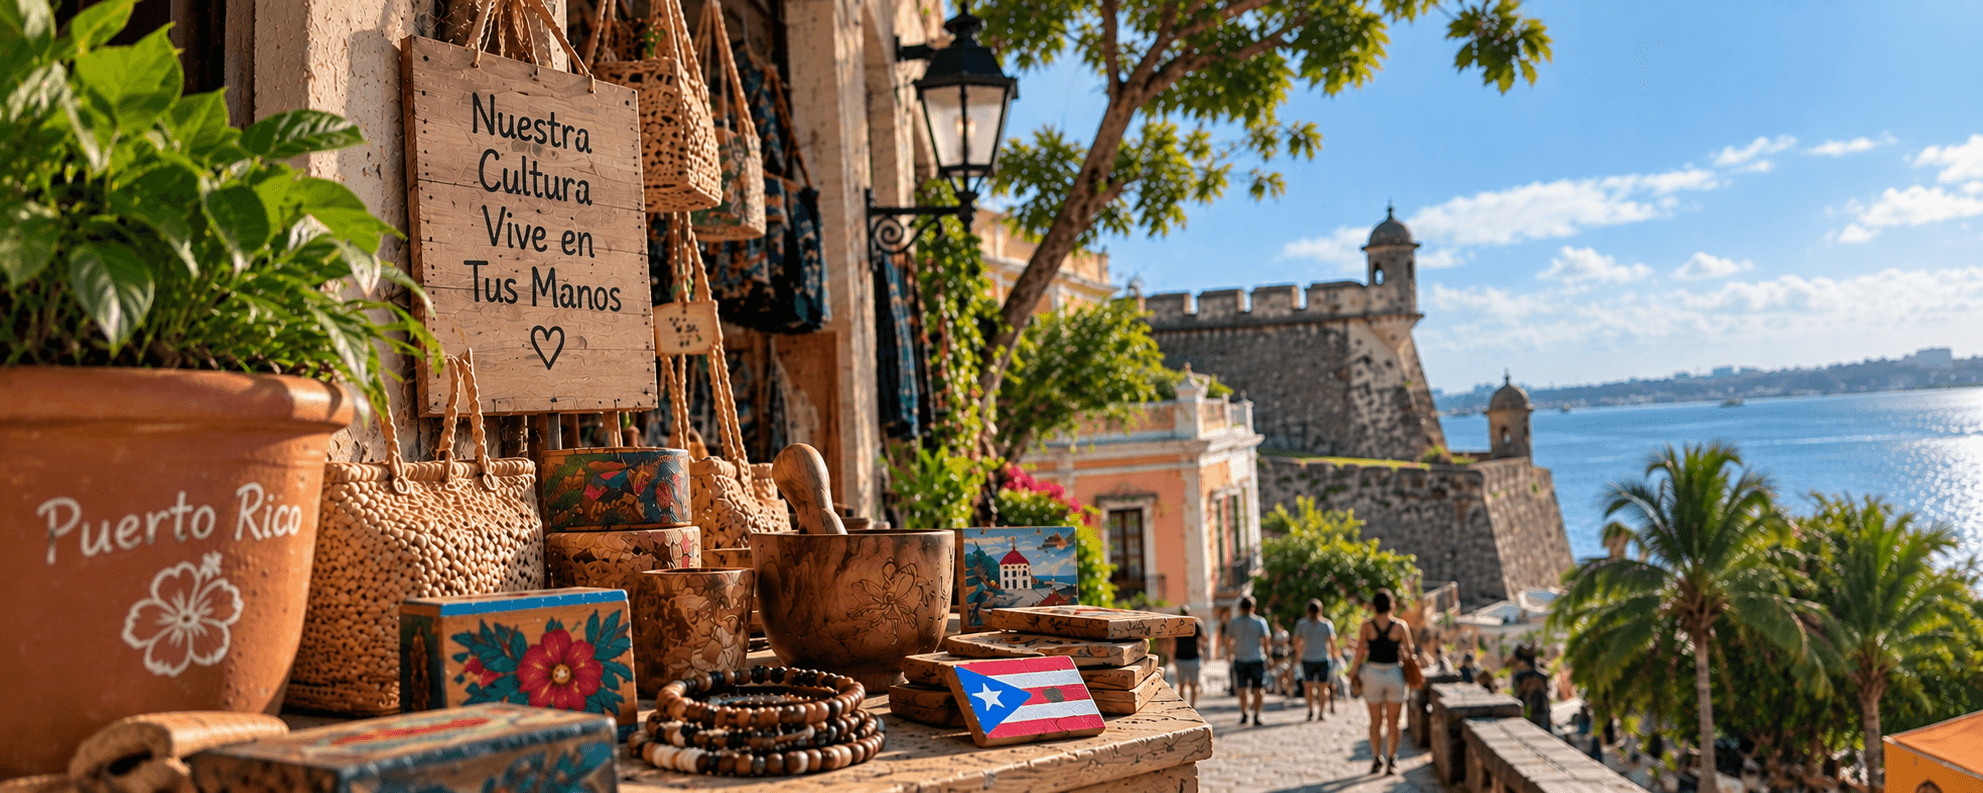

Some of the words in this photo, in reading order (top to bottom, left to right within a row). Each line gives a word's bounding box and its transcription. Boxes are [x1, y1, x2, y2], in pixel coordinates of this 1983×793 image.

[471, 91, 592, 154] Nuestra
[478, 148, 592, 206] Cultura
[482, 204, 547, 252] Vive
[561, 229, 595, 258] en
[463, 260, 518, 304] Tus
[531, 266, 622, 312] Manos
[37, 490, 216, 565] Puerto
[234, 482, 302, 542] Rico
